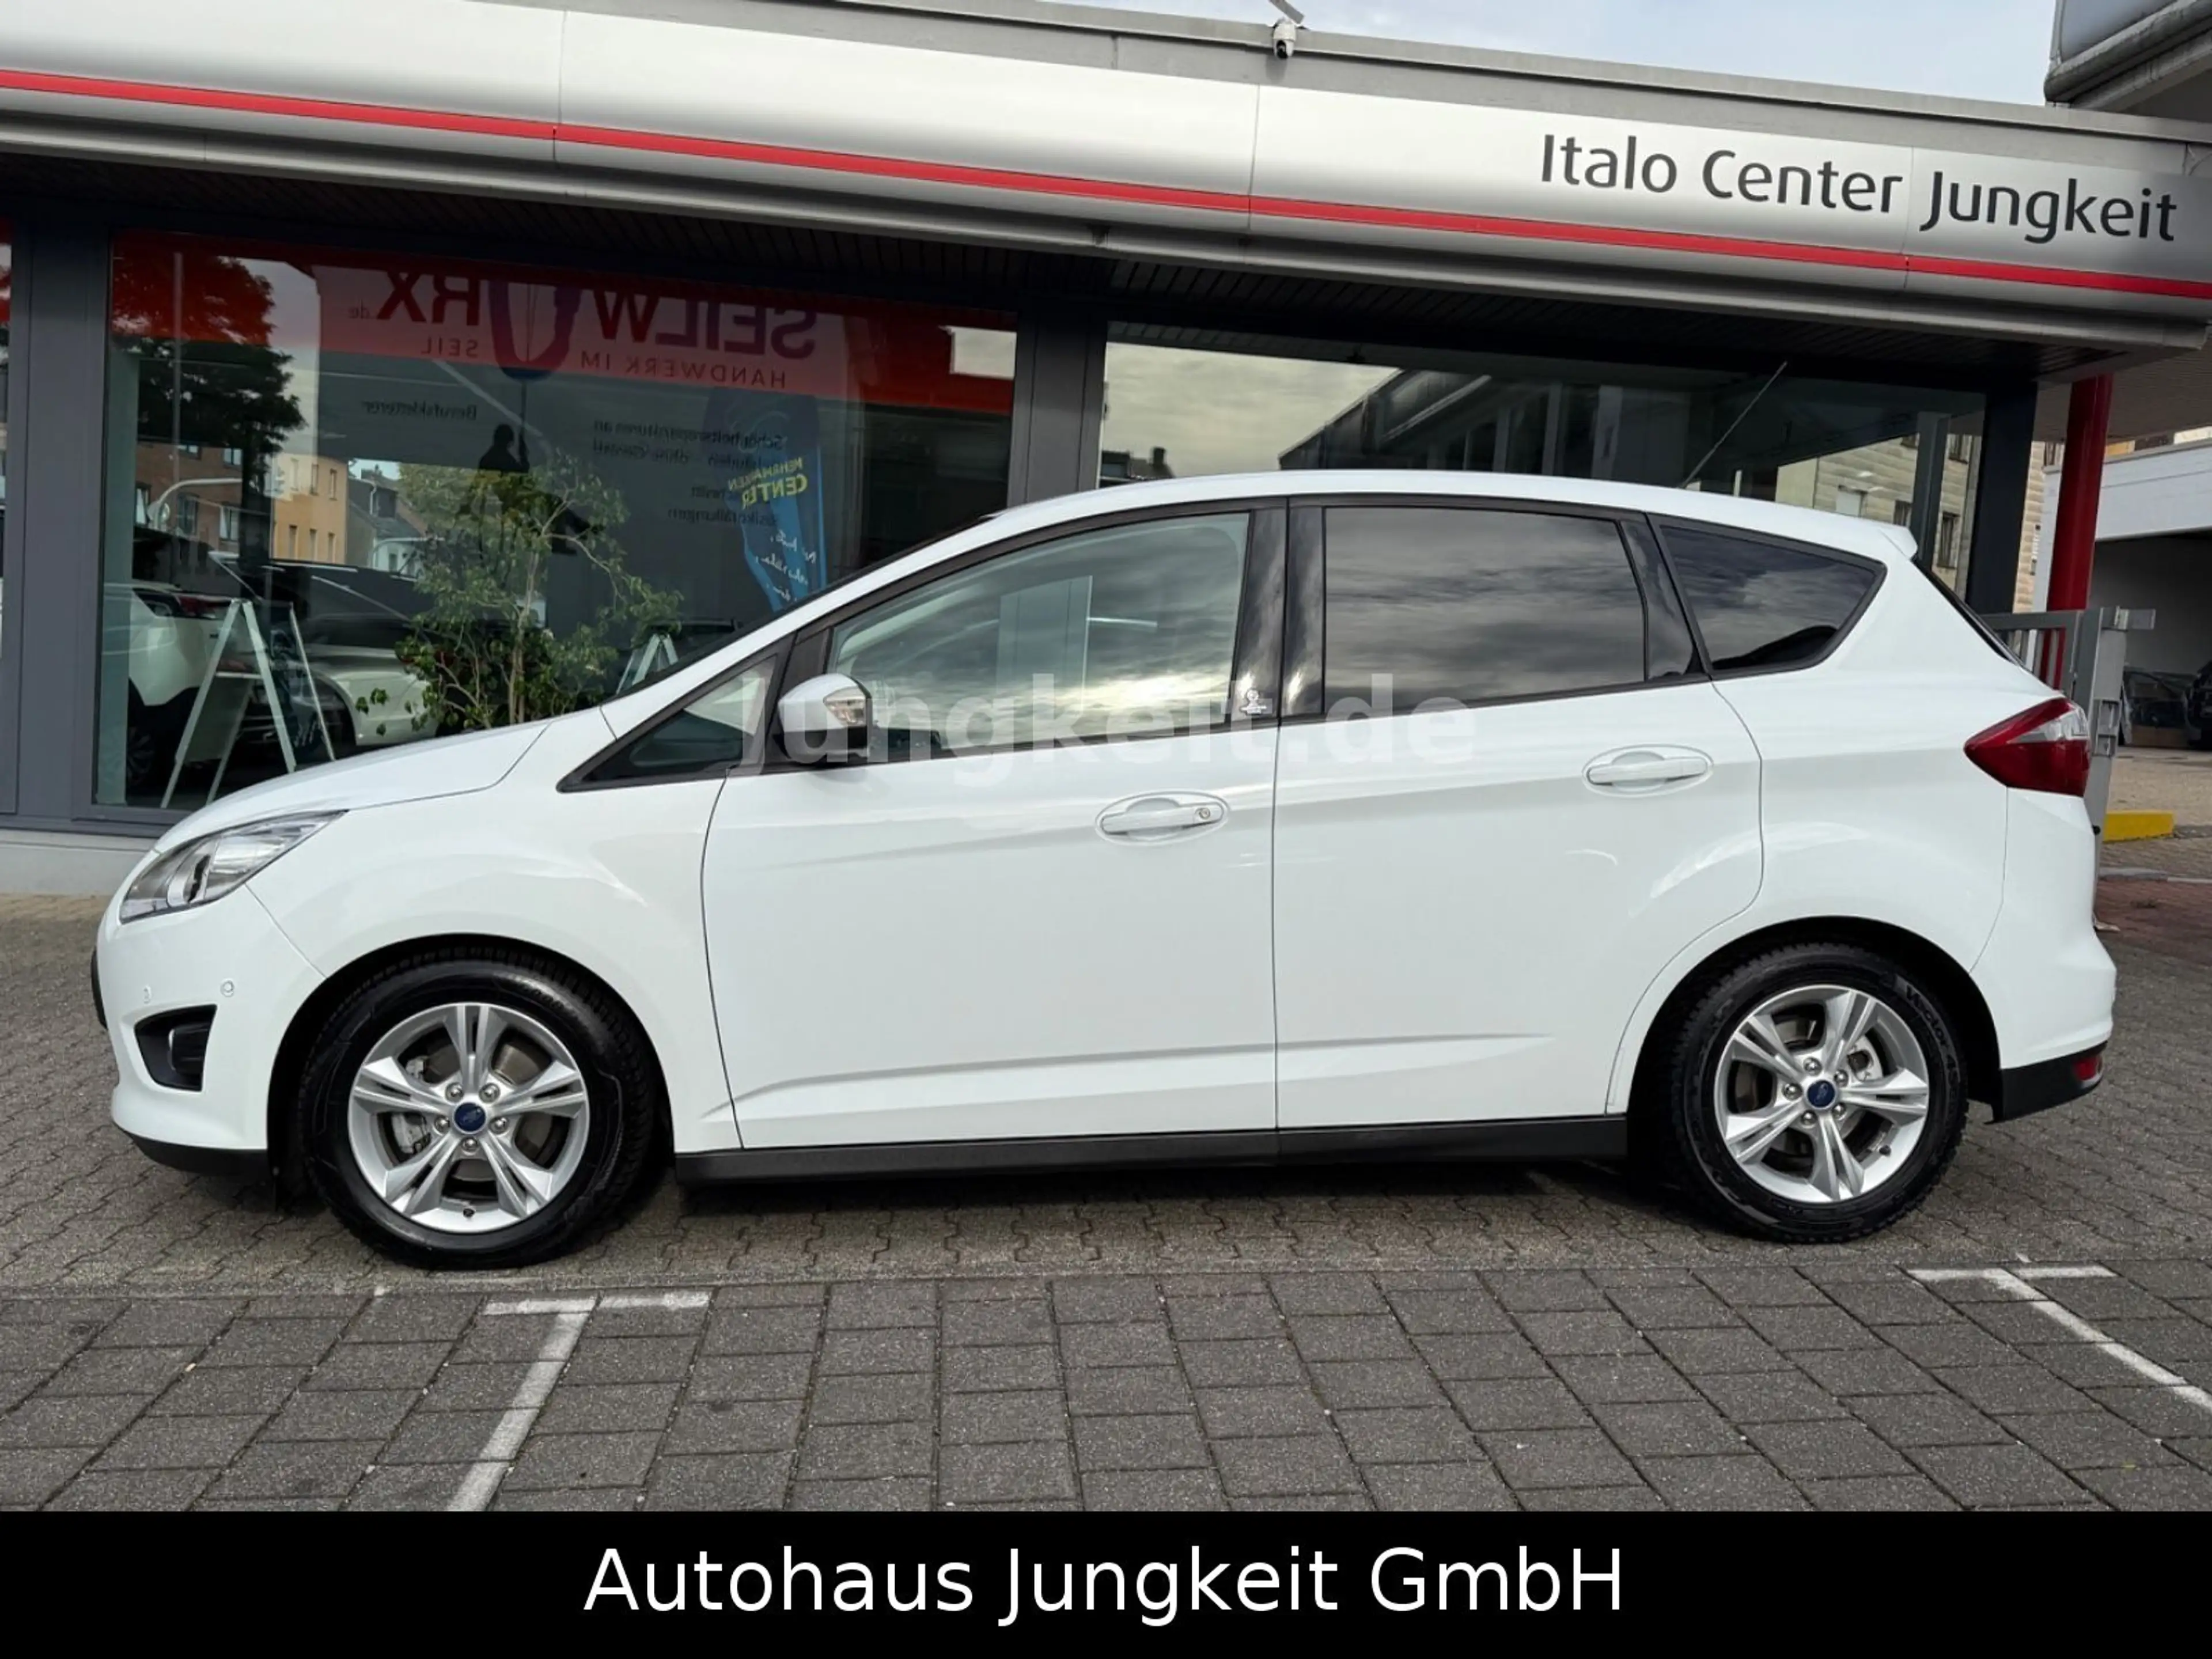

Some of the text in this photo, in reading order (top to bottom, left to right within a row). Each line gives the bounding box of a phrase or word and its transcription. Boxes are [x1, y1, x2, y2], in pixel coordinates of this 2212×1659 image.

[1541, 135, 2177, 244] Italo Center Jungkeit
